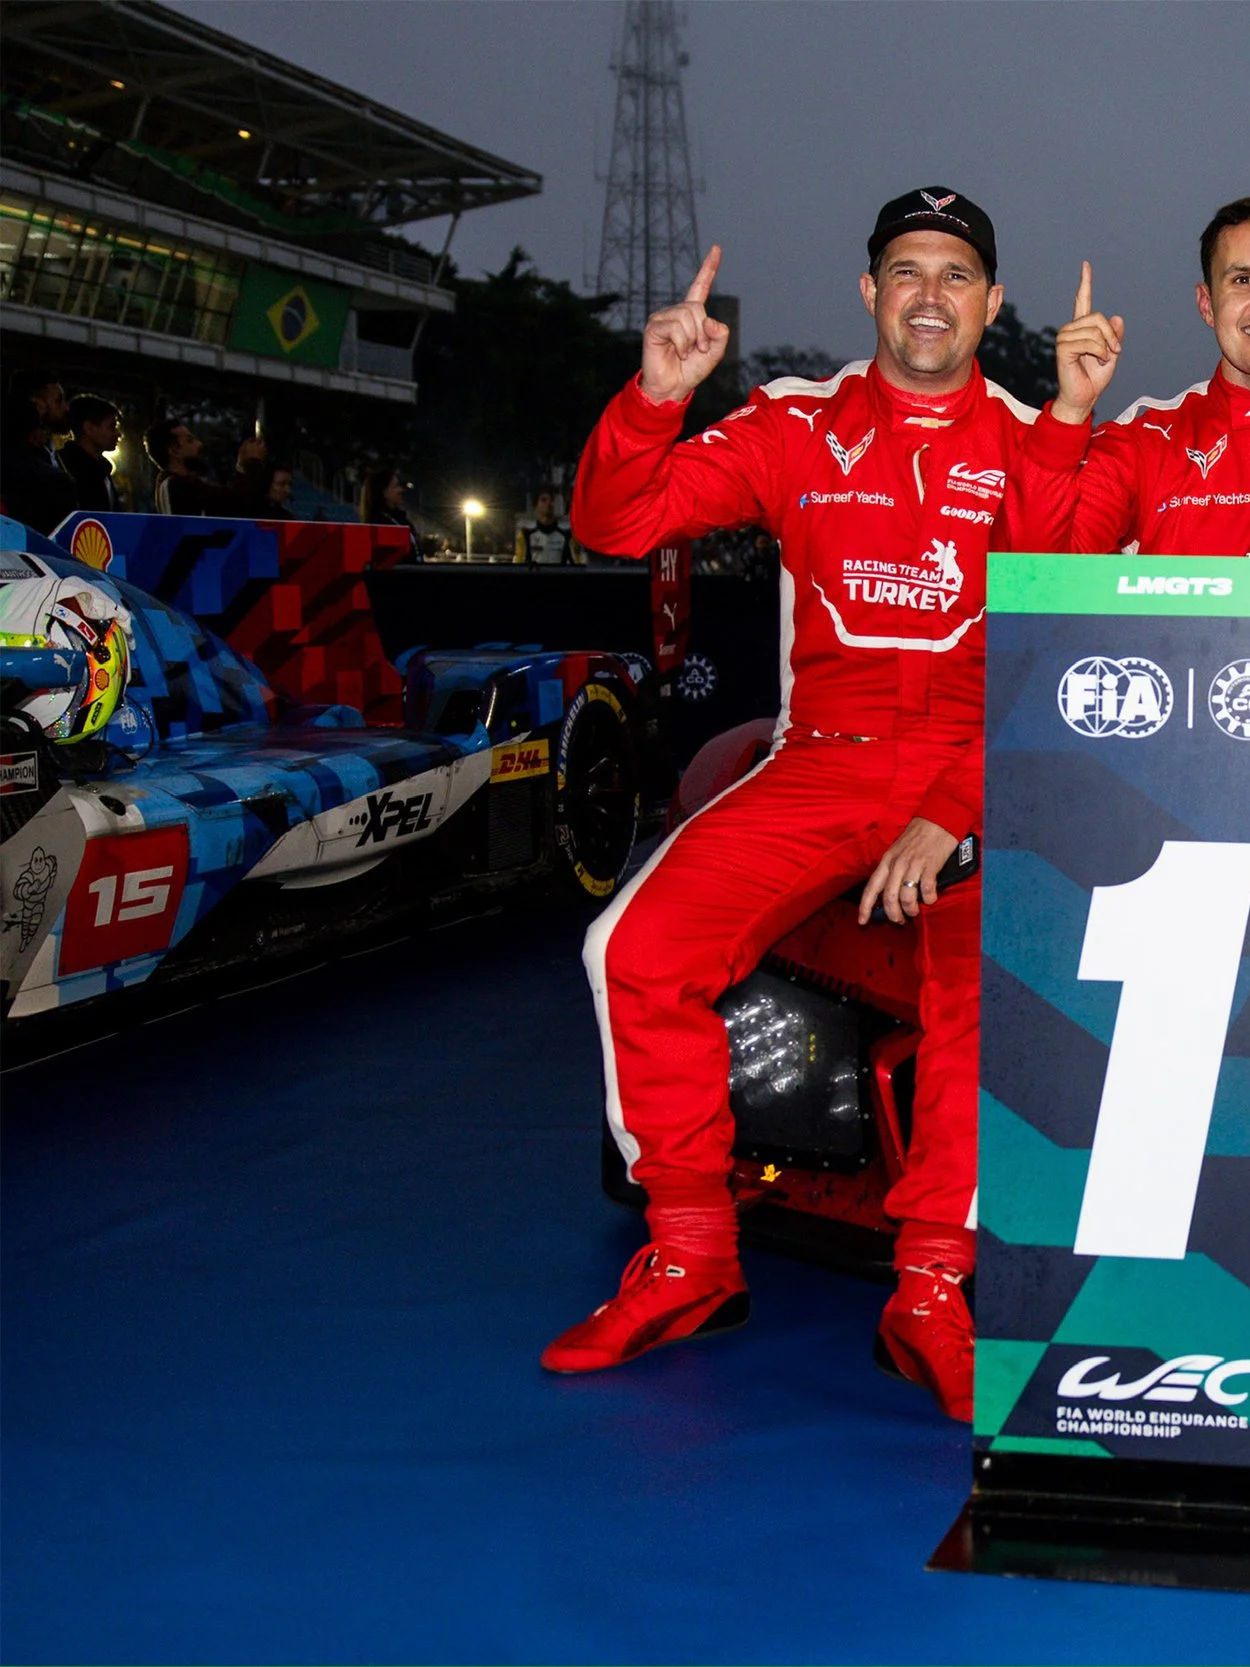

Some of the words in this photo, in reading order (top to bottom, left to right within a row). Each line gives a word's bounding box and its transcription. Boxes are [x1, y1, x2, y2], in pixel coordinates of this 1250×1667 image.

[856, 491, 895, 507] Yachts
[1213, 492, 1250, 505] Yachts
[940, 505, 995, 525] GOODY
[843, 559, 897, 574] RACING
[898, 564, 941, 582] TEAM
[843, 578, 959, 613] TURKEY
[1116, 576, 1233, 596] LMGT3
[499, 749, 543, 775] DHL
[0, 765, 34, 782] AMPION
[356, 791, 433, 847] XPEL
[88, 865, 174, 927] 15
[1056, 1406, 1083, 1419] FIA
[1086, 1408, 1146, 1424] WORLD
[1149, 1411, 1249, 1429] ENDURANCE
[1056, 1420, 1181, 1438] CHAMPIONSHIP
